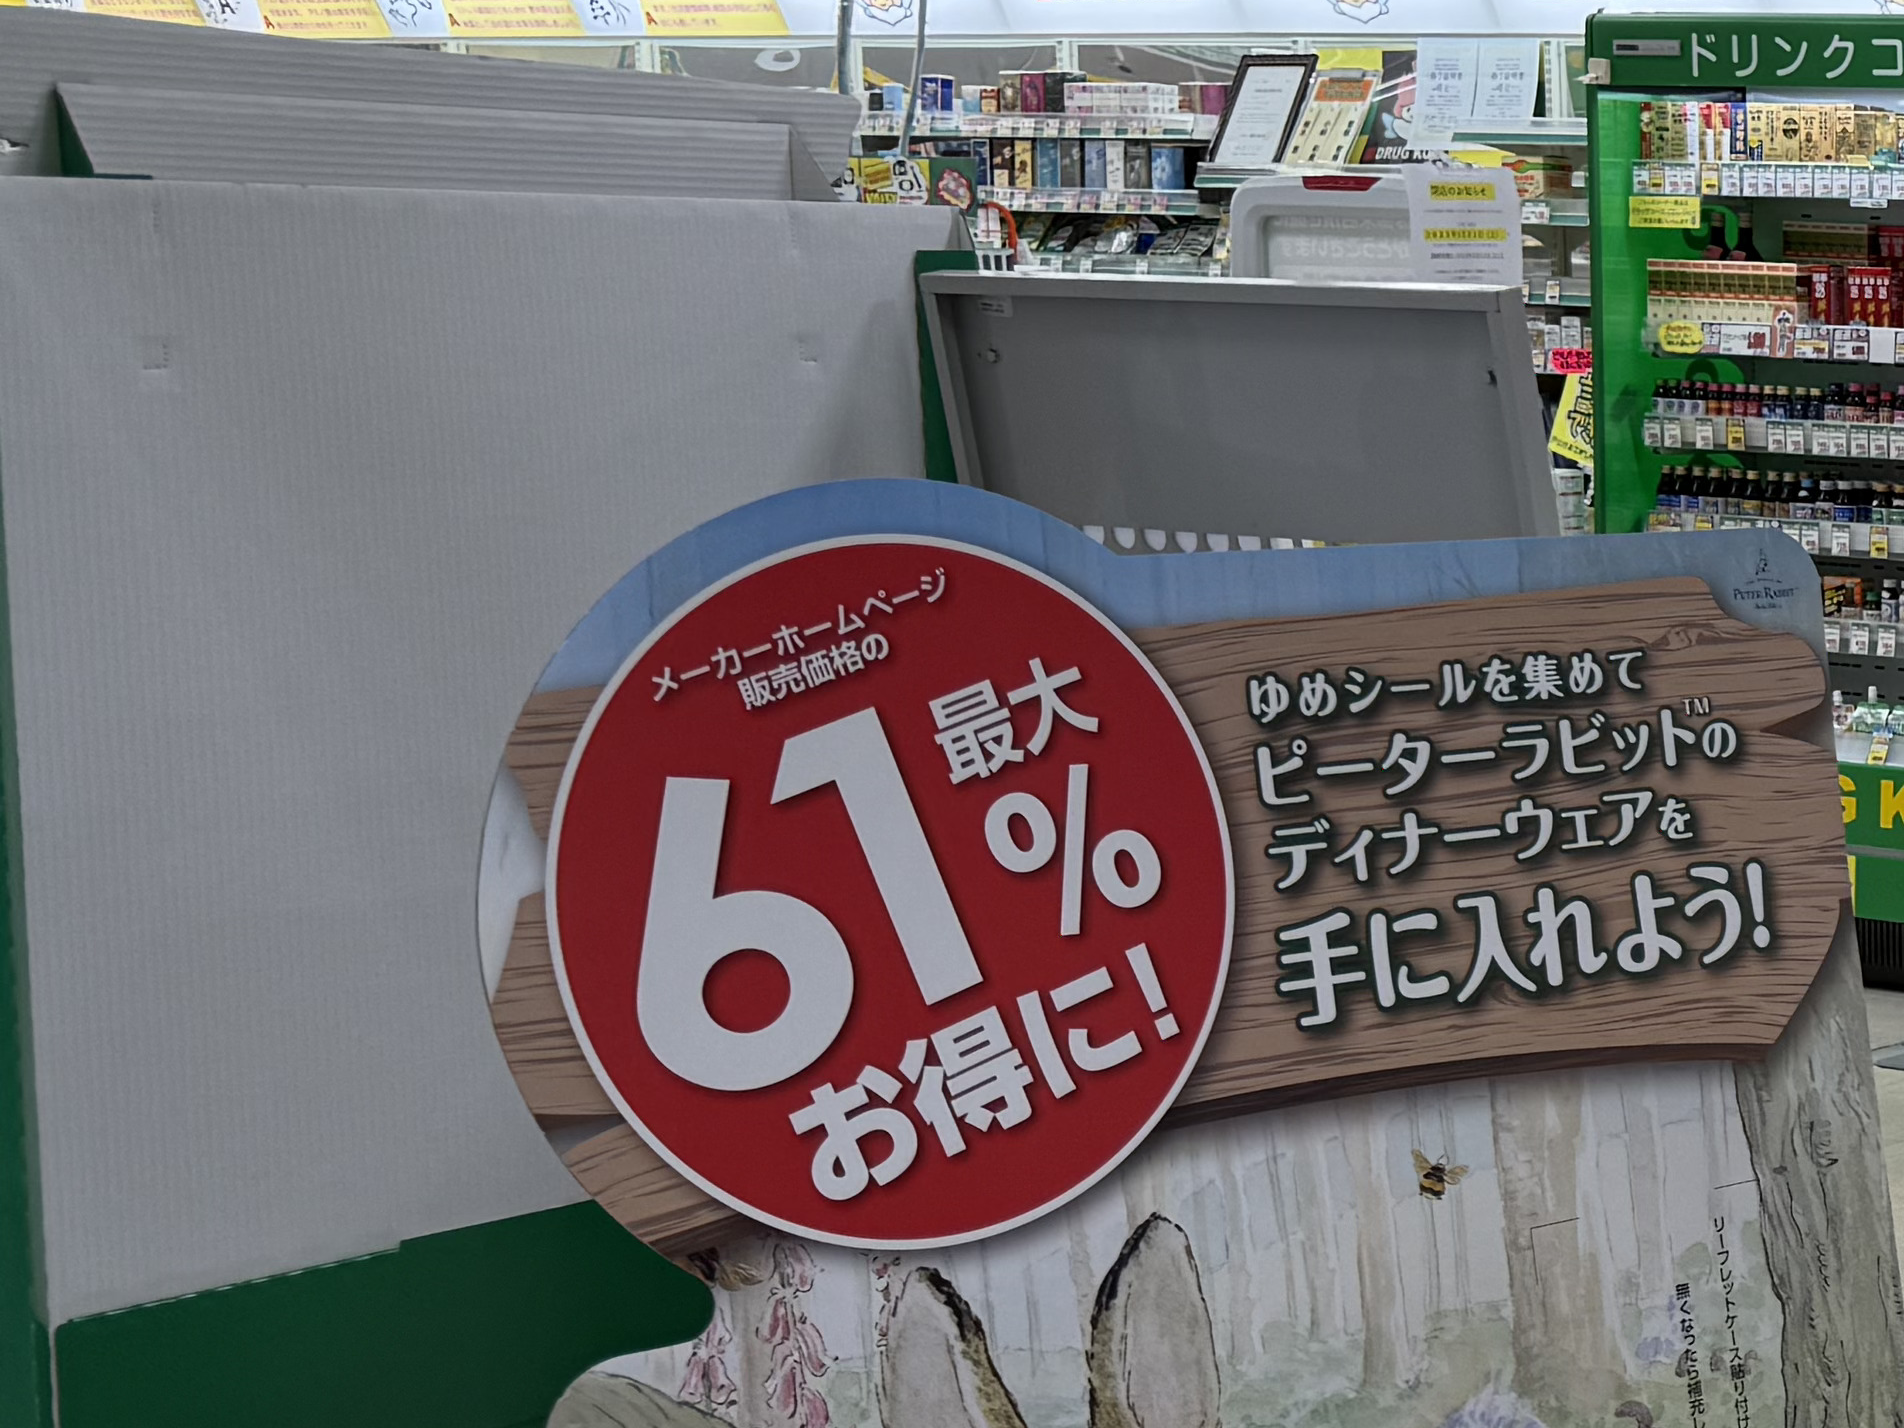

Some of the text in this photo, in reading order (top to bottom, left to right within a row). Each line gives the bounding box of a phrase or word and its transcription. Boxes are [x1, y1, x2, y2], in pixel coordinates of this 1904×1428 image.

[650, 567, 949, 703] メーカーホームページ
[736, 631, 892, 712] 販売価格の
[1249, 650, 1645, 725] ゆめシールを集めて
[927, 656, 1100, 787] 最大
[1267, 789, 1696, 891] ディナーウェアを
[1279, 861, 1772, 1028] 手に入れよう!
[788, 941, 1181, 1202] お得に!
